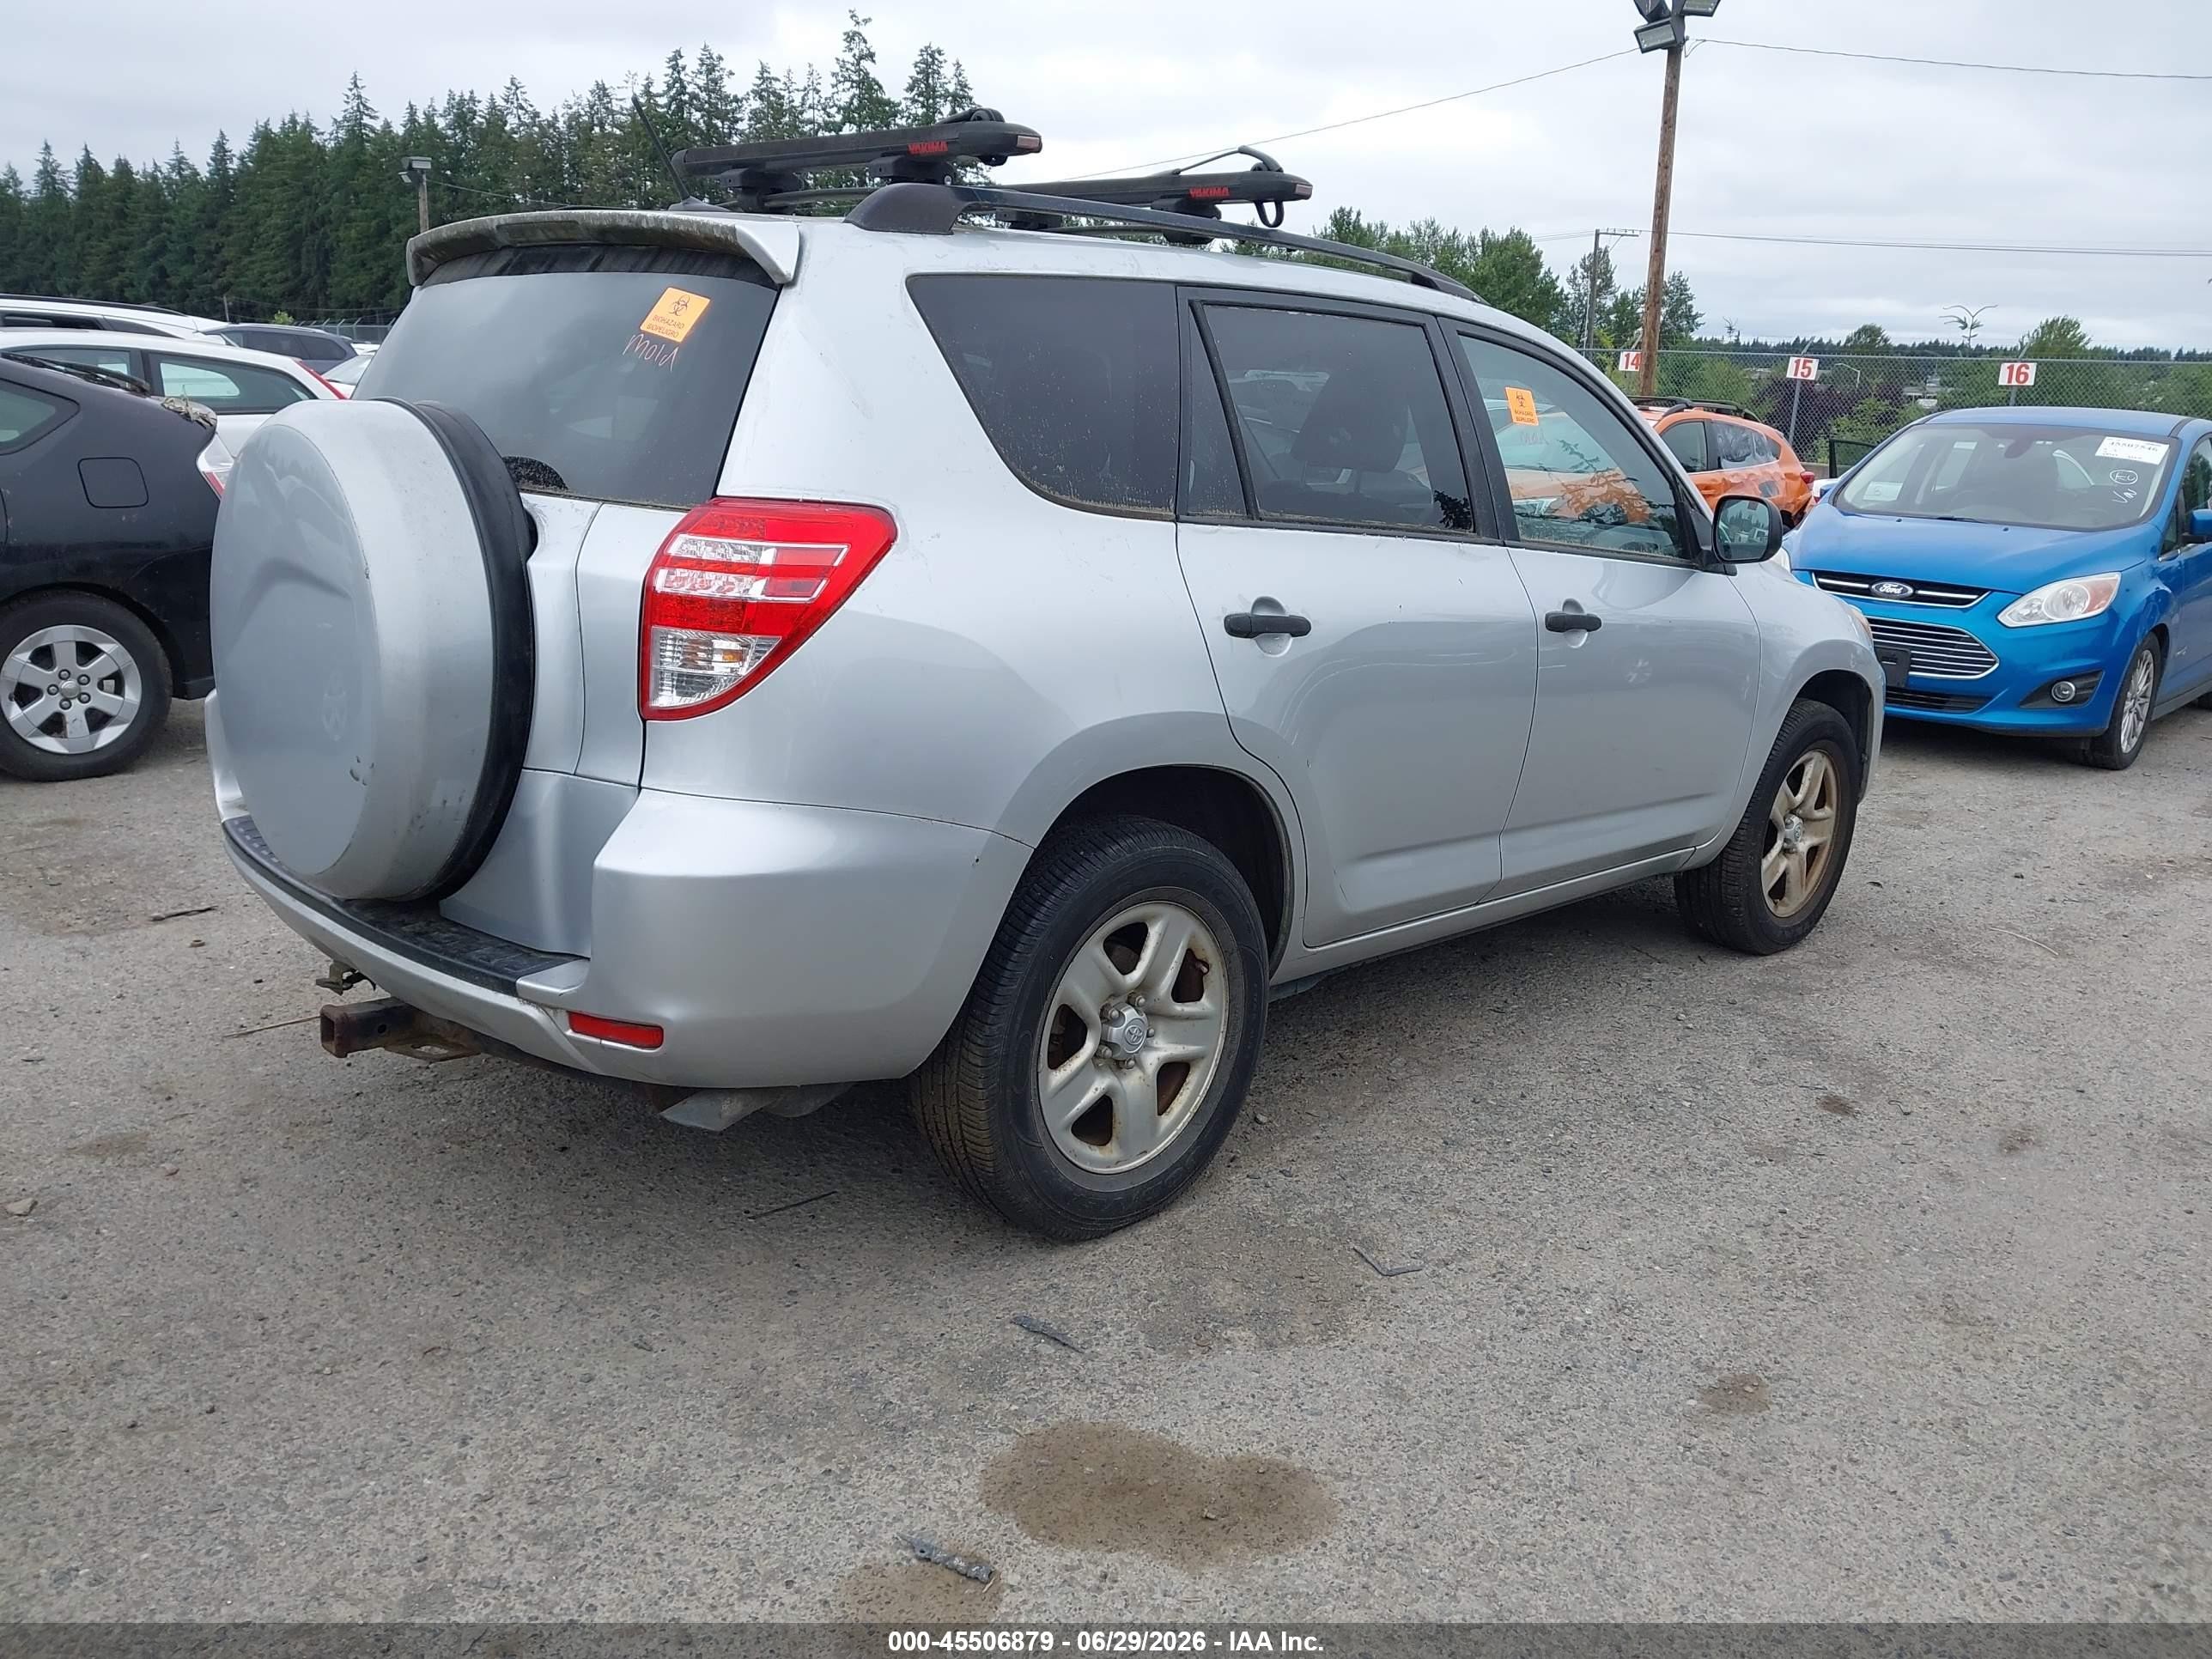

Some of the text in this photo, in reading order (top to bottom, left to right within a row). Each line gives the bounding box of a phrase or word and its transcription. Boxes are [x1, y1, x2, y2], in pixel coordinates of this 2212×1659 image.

[908, 141, 948, 155] YAKIMA
[1188, 185, 1230, 198] YAKIMA
[1625, 353, 1643, 370] 14
[1794, 358, 1814, 378] 15
[2007, 363, 2029, 384] 16
[1879, 583, 1904, 594] Ford
